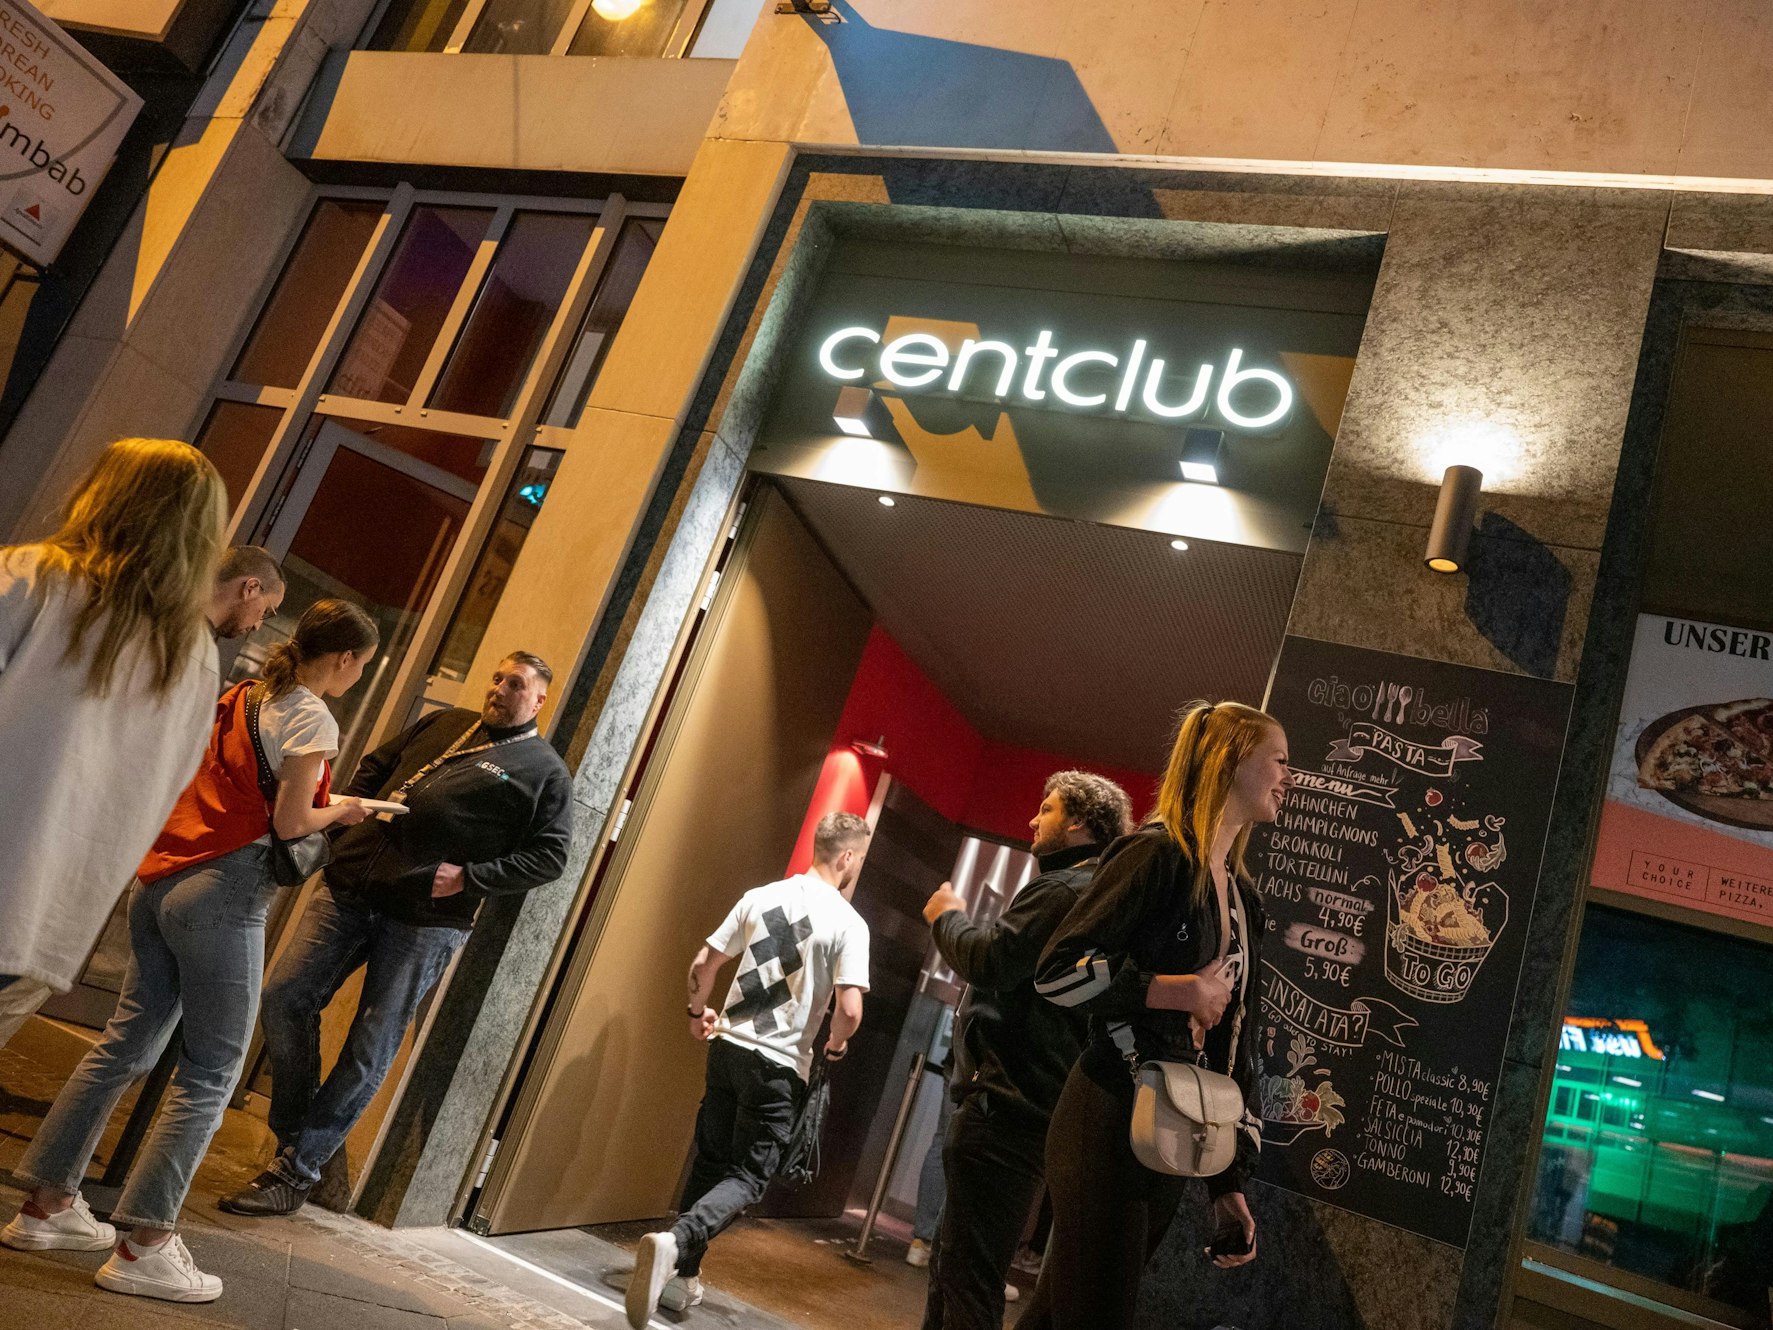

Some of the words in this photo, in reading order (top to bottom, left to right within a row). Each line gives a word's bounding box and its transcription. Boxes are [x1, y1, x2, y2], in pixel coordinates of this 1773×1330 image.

[0, 37, 54, 91] REAN
[0, 122, 85, 196] mbab
[818, 325, 1294, 428] centclub
[1664, 621, 1771, 660] UNSER
[1410, 687, 1489, 734] bella
[1372, 731, 1425, 766] PASTA
[1292, 772, 1355, 796] menu
[1321, 762, 1336, 775] auf
[1336, 763, 1367, 782] Anfrage
[1256, 872, 1302, 903] LACHS
[1642, 872, 1692, 890] CHOICE
[1644, 860, 1694, 879] YOUR
[1721, 876, 1773, 896] WEITERE
[1719, 890, 1763, 909] PIZZA,
[1318, 906, 1366, 937] 4,90€
[1304, 956, 1352, 987] 5,90€
[1268, 975, 1364, 1041] INSALATA?
[1260, 1001, 1268, 1013] O
[1283, 1023, 1300, 1037] oder
[1306, 1036, 1317, 1047] TO
[1321, 1043, 1353, 1060] STAY!
[1380, 1050, 1421, 1080] MISTA
[1458, 1074, 1491, 1101] 8,90€
[1375, 1071, 1412, 1100] POLLO
[1450, 1097, 1484, 1127] 10,90€
[1364, 1134, 1406, 1161] TONNO
[1447, 1159, 1477, 1182] 9,90€
[1446, 1139, 1480, 1164] 12,90€
[1357, 1151, 1431, 1188] GAMBERONI
[1440, 1175, 1473, 1202] 12,90€
